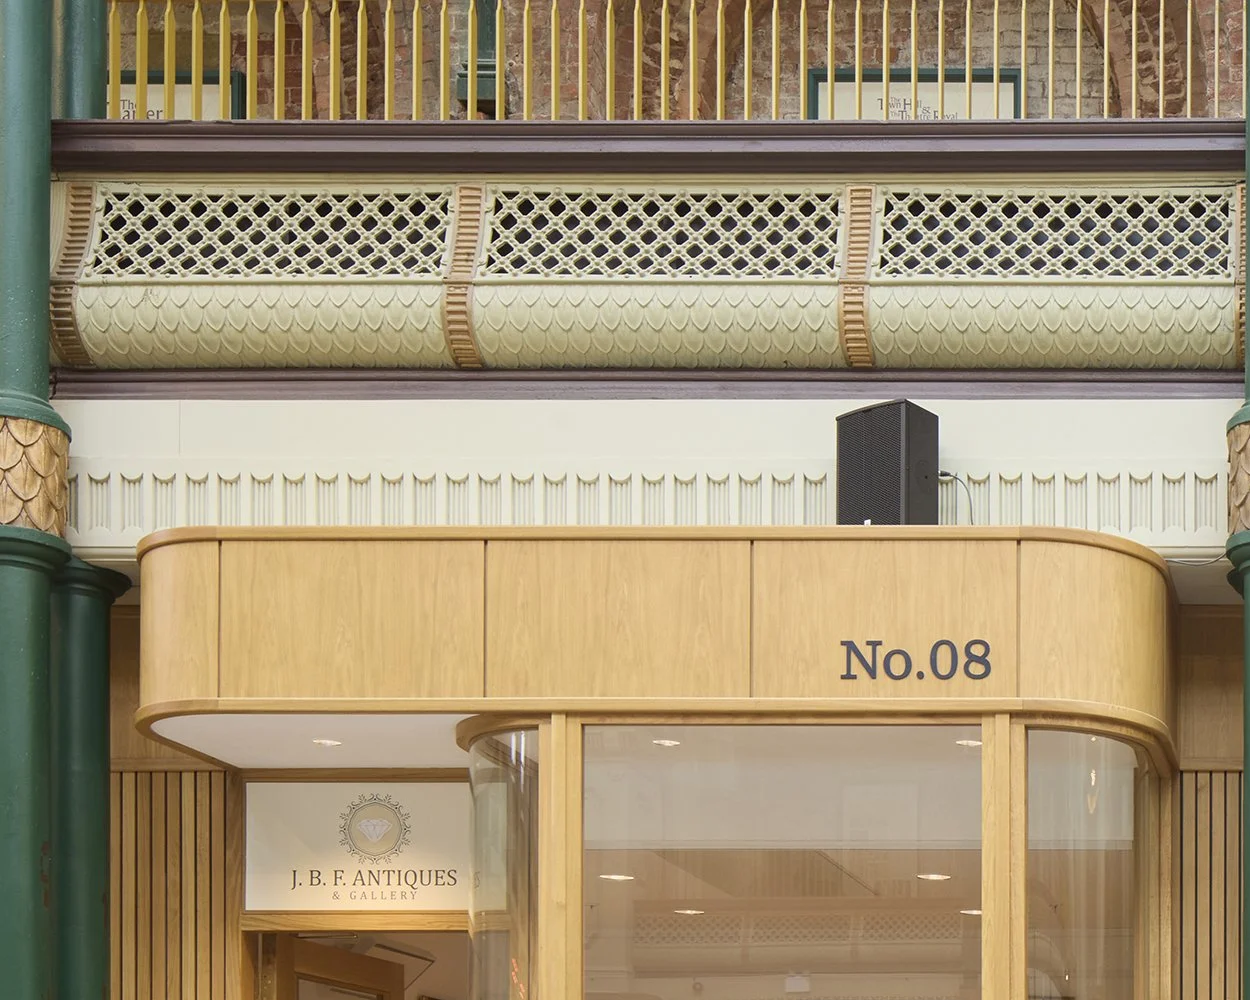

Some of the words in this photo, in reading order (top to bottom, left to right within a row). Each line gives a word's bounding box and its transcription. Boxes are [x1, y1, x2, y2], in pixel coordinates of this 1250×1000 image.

[877, 98, 901, 110] Twn
[903, 98, 922, 111] Hll
[840, 639, 991, 680] No.08
[291, 869, 302, 890] J.
[309, 869, 326, 886] B.
[333, 869, 346, 886] F.
[352, 869, 458, 890] ANTIQUES
[332, 890, 340, 900] &
[350, 890, 418, 900] GALLERY
